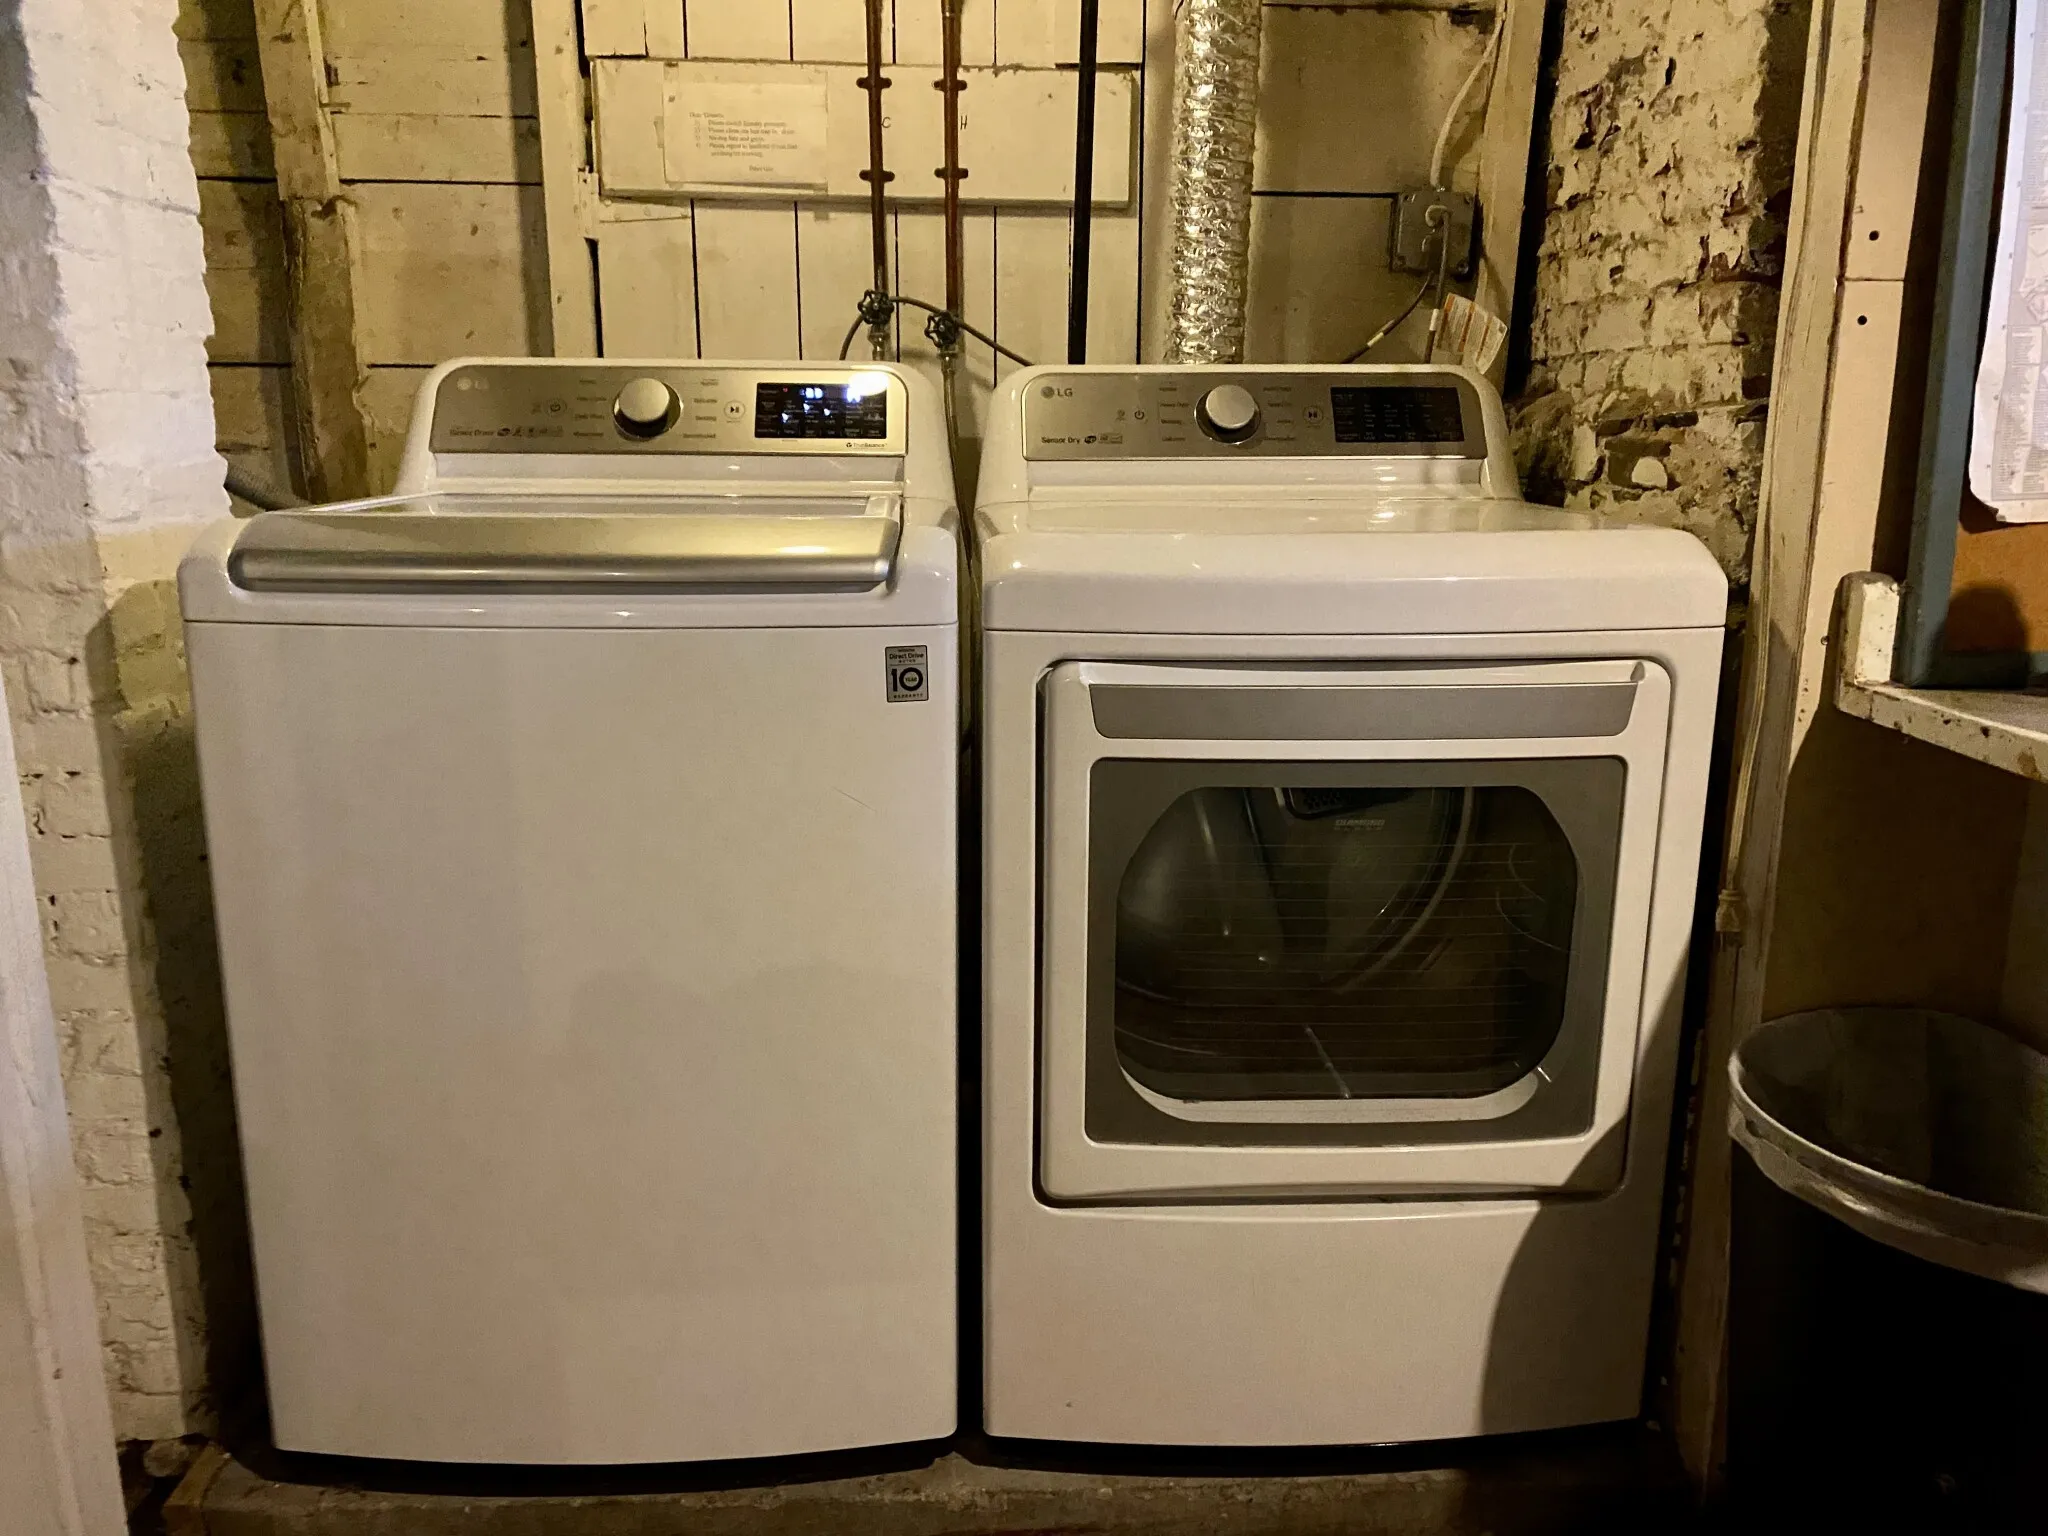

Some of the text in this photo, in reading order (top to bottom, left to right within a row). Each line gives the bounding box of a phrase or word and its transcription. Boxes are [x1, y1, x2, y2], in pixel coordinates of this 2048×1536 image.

[882, 116, 891, 129] C
[960, 115, 968, 130] H
[1041, 437, 1066, 445] Sensor
[1068, 437, 1081, 445] Dry
[891, 667, 924, 692] 10
